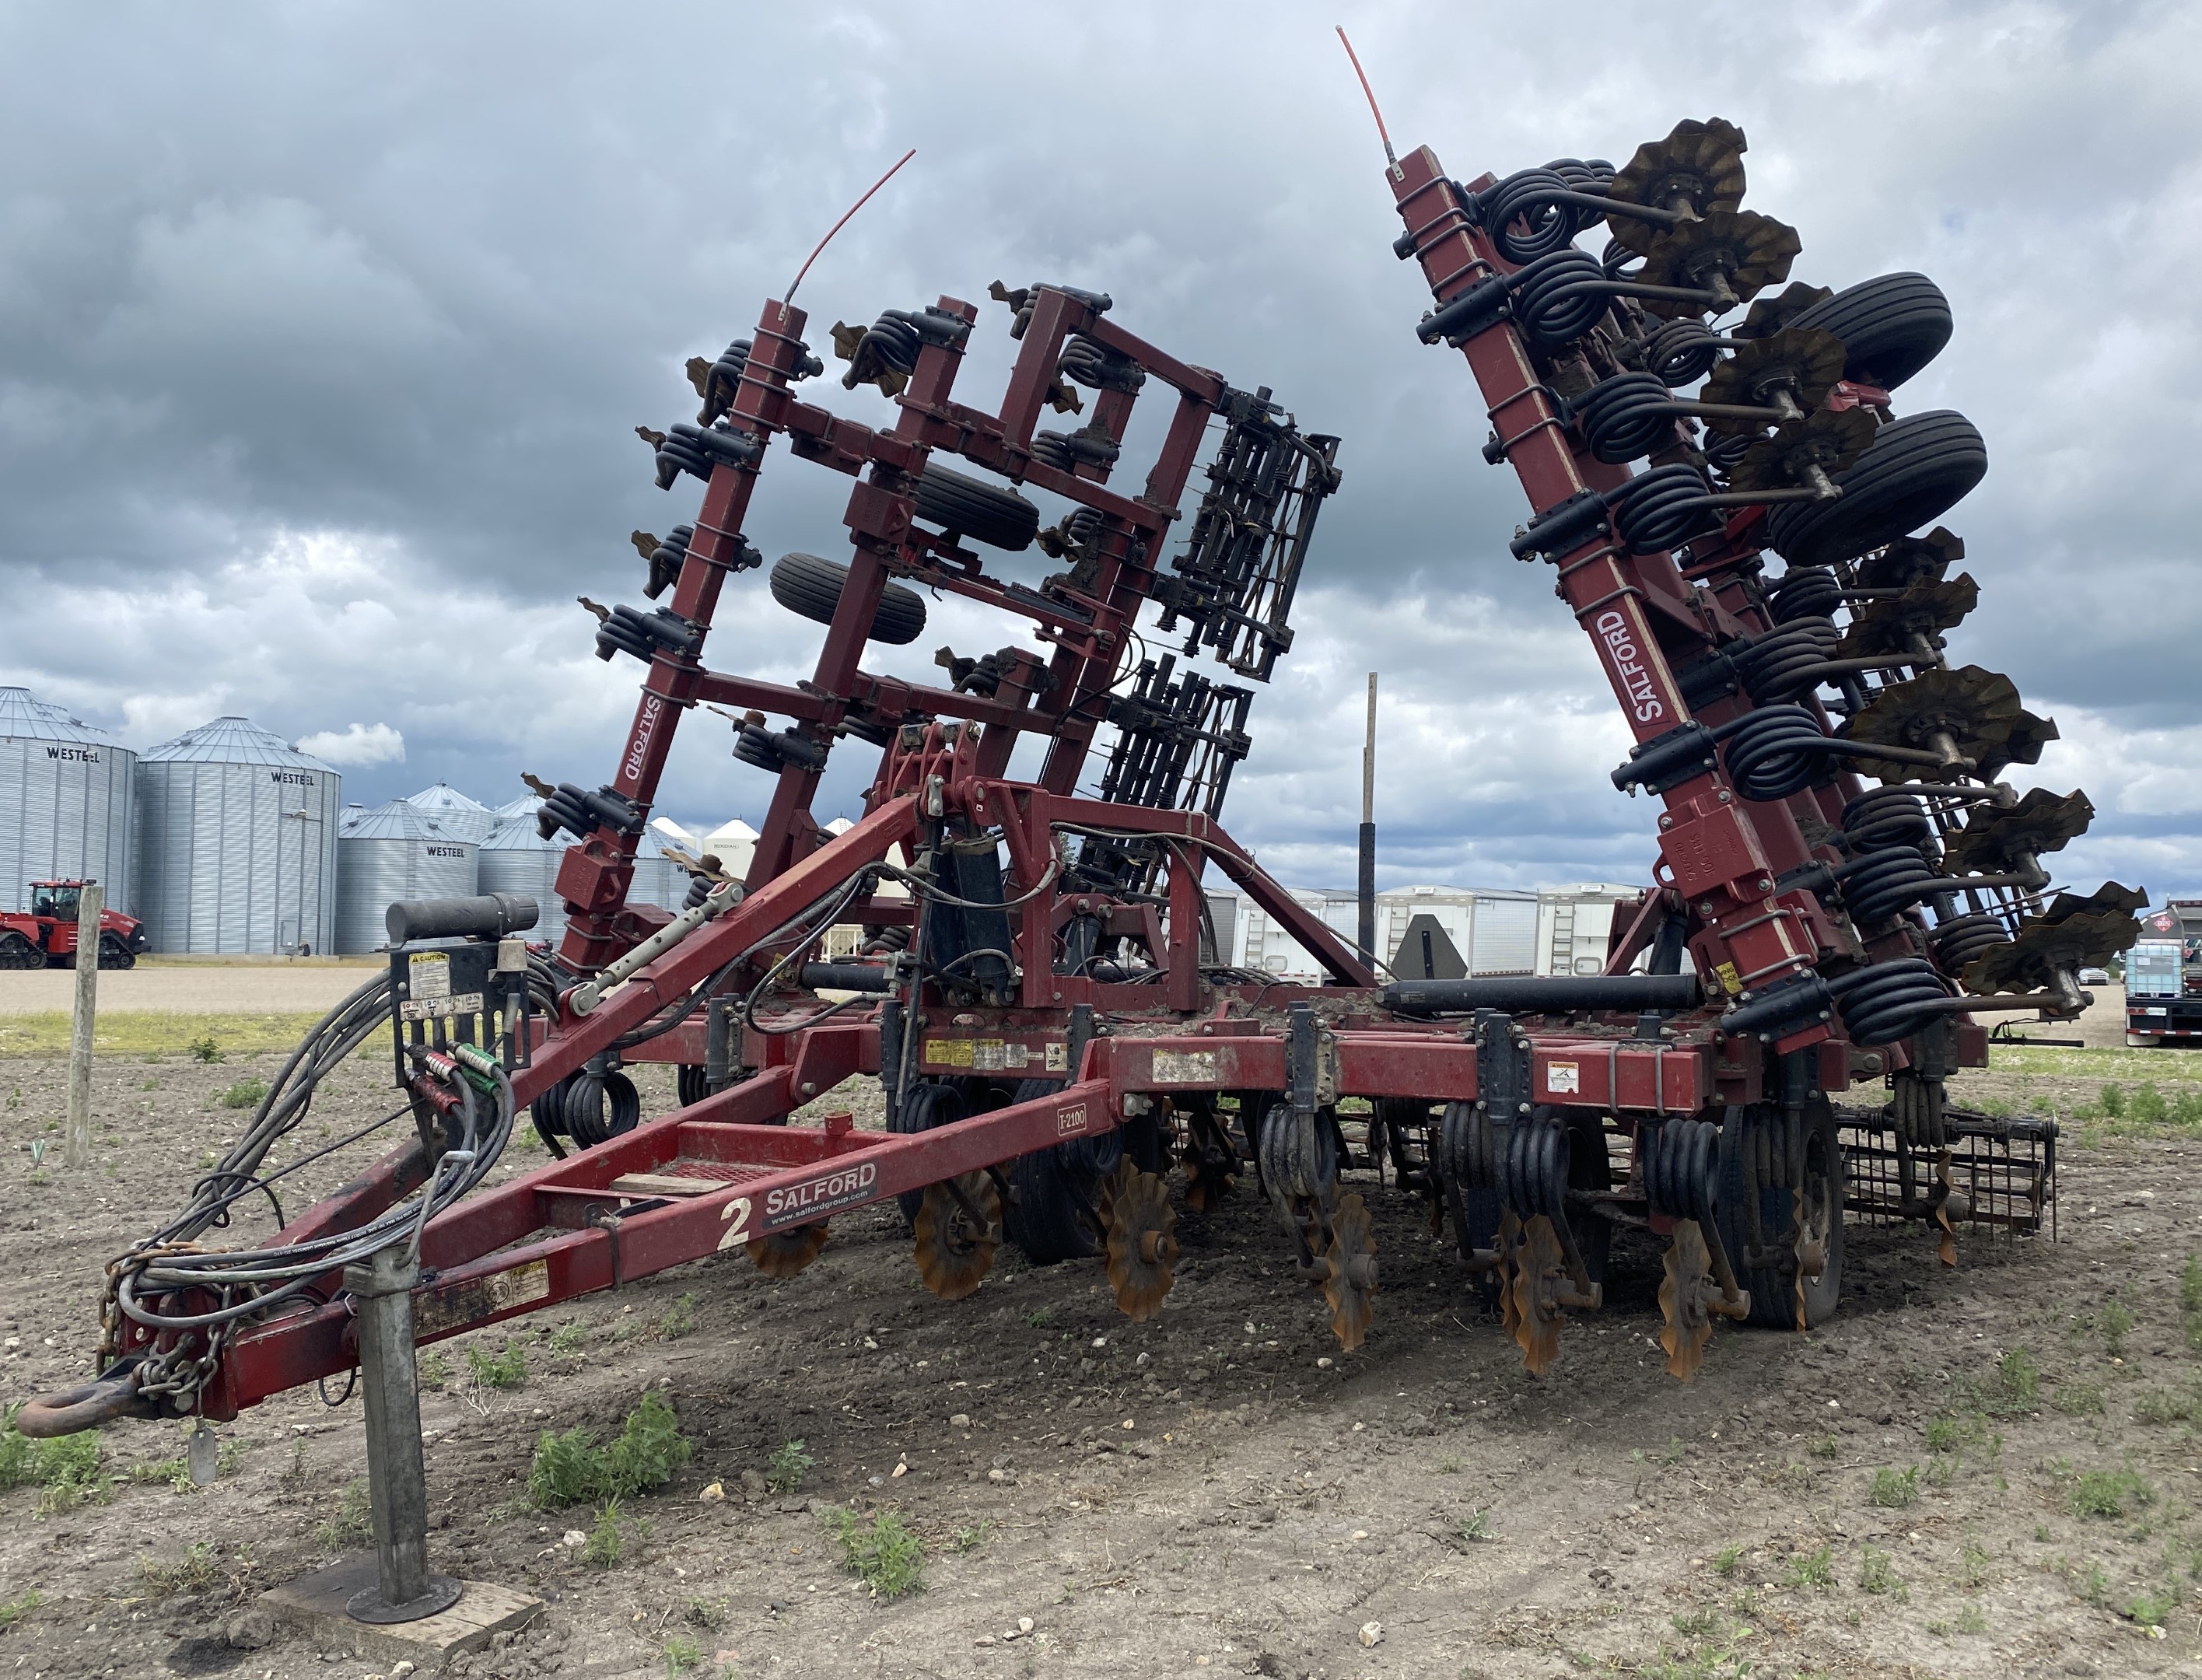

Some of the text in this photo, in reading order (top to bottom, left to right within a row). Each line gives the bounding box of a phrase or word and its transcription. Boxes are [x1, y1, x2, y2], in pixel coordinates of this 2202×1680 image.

[1595, 610, 1663, 723] SALFORD
[47, 747, 100, 763] WESTEEL
[625, 695, 661, 781] SALFORD
[271, 772, 314, 786] WESTEEL
[426, 845, 465, 858] WESTEEL
[1675, 842, 1697, 881] SALFORD
[1689, 833, 1716, 877] 100 LBS
[1722, 974, 1737, 982] OCK
[1059, 1109, 1085, 1130] I-2100
[765, 1162, 877, 1215] SALFORD
[716, 1197, 752, 1251] 2
[771, 1190, 869, 1226] www.salfordgroup.com
[518, 1262, 544, 1276] CAUTION
